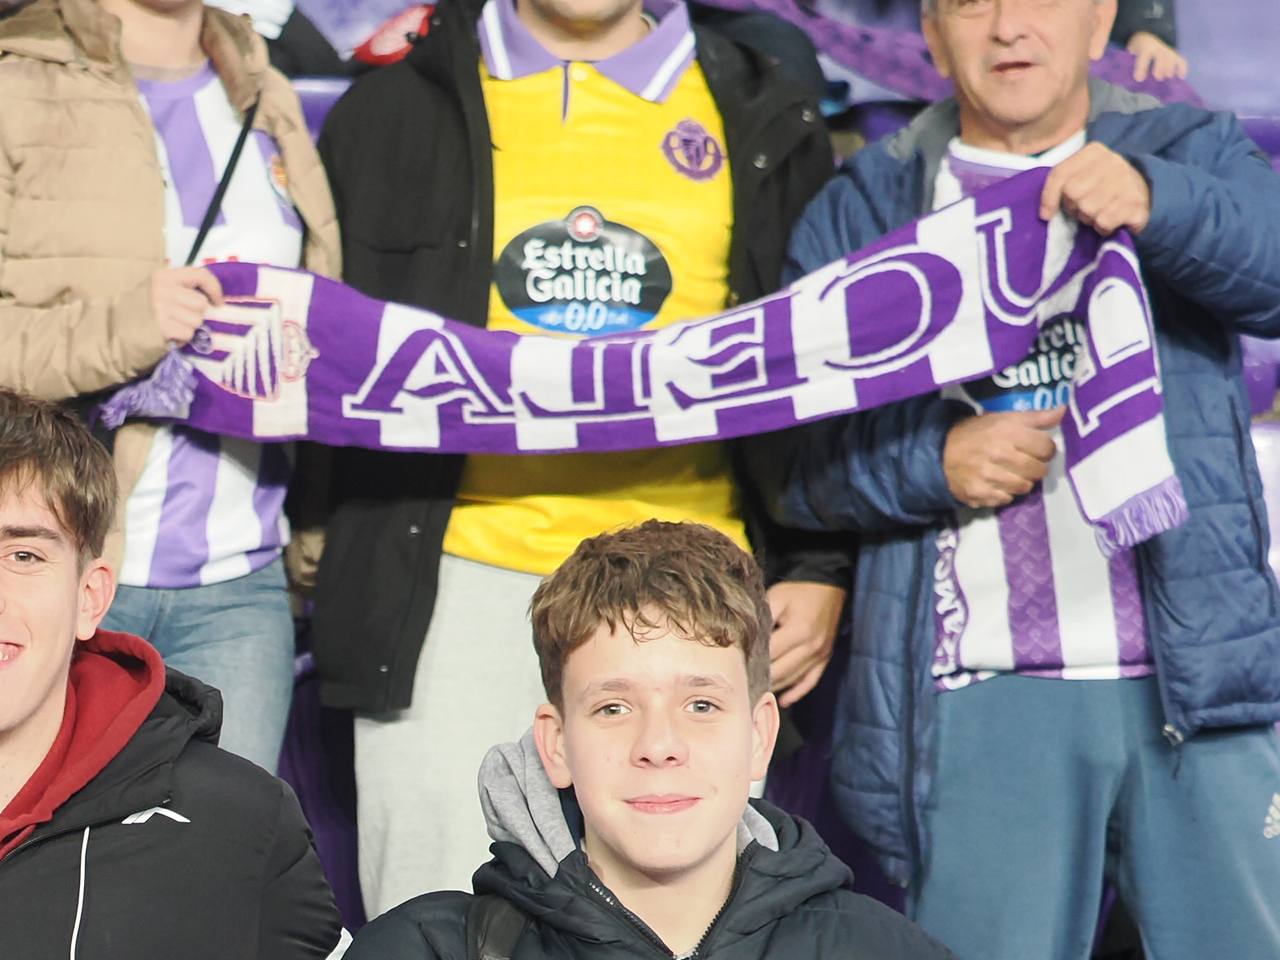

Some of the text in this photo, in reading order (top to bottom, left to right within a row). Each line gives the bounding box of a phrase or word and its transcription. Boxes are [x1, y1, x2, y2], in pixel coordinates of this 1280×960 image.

[521, 237, 647, 276] Estrella
[525, 268, 642, 305] Galicia
[564, 301, 609, 331] 0,0
